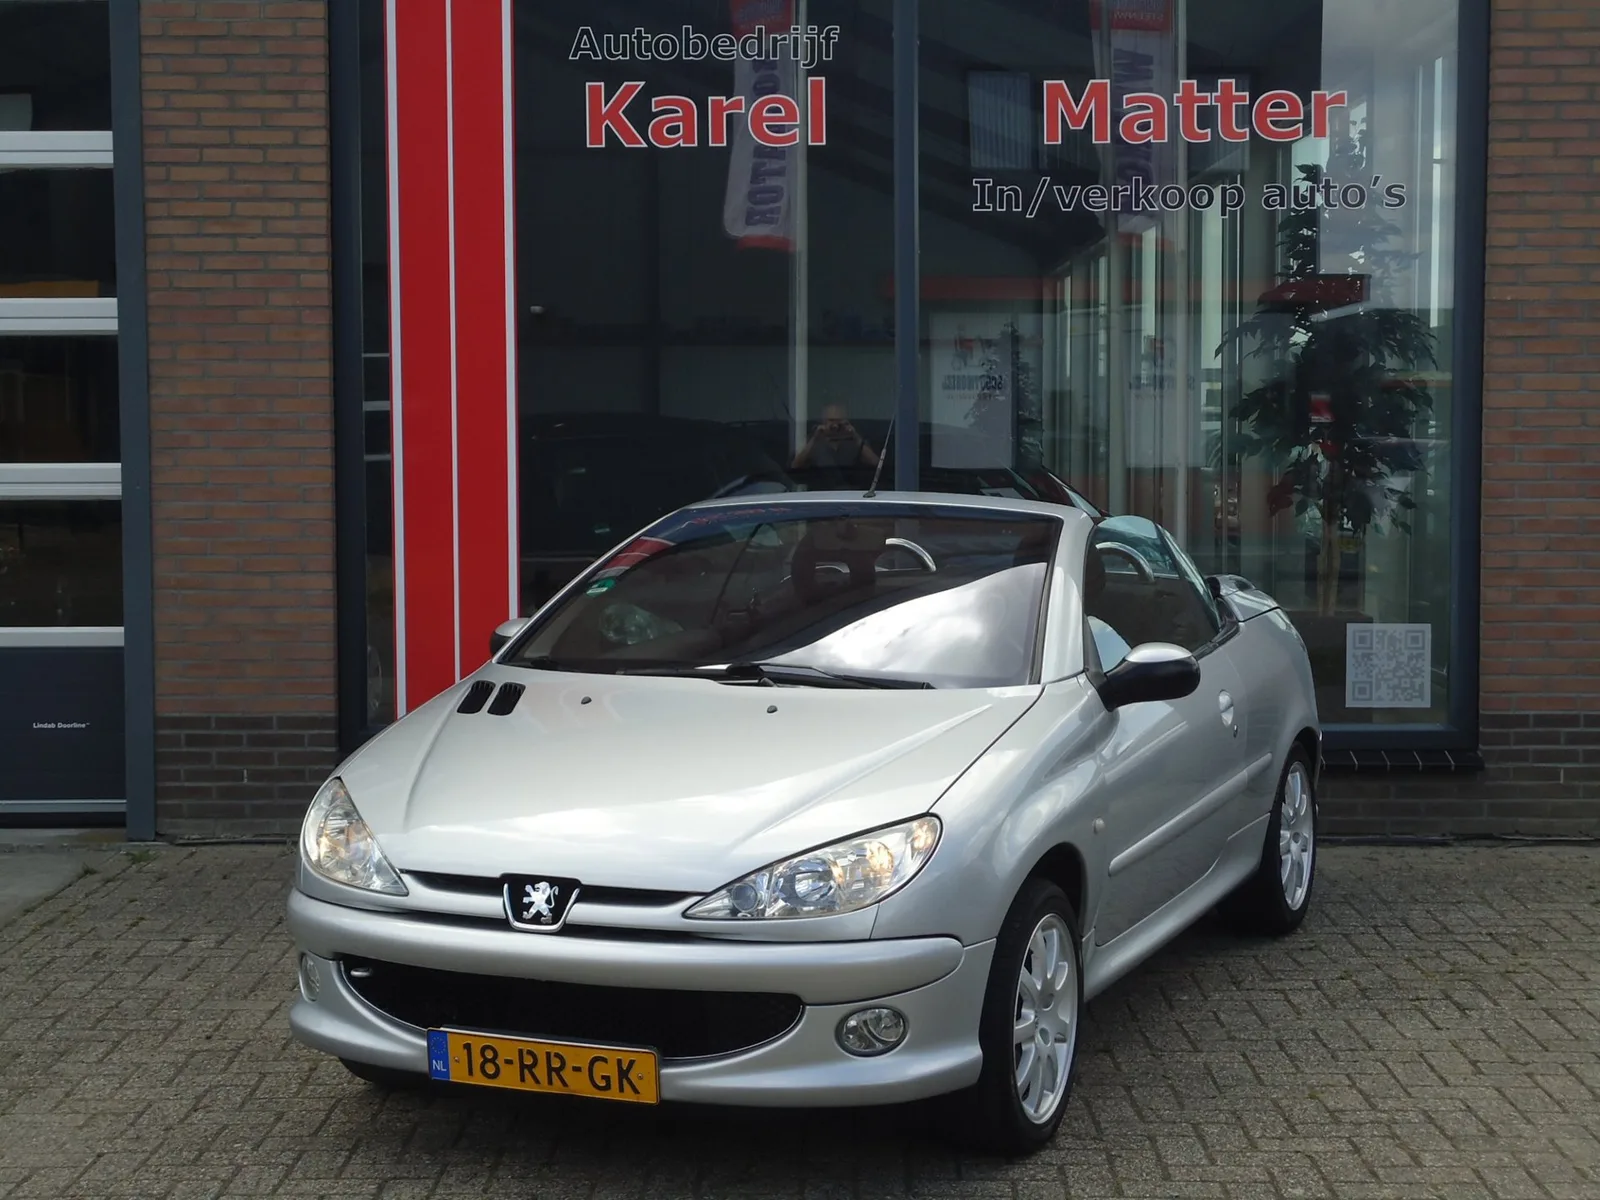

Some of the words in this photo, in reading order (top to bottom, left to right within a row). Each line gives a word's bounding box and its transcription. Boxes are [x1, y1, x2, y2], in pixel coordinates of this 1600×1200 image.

[569, 26, 840, 69] Autobedrijf
[585, 76, 827, 149] Karel
[1042, 79, 1348, 145] Matter
[971, 177, 1246, 218] In/verkoop
[1261, 175, 1407, 211] auto's
[432, 1059, 447, 1072] NL
[463, 1043, 640, 1094] 18-RR-GK
